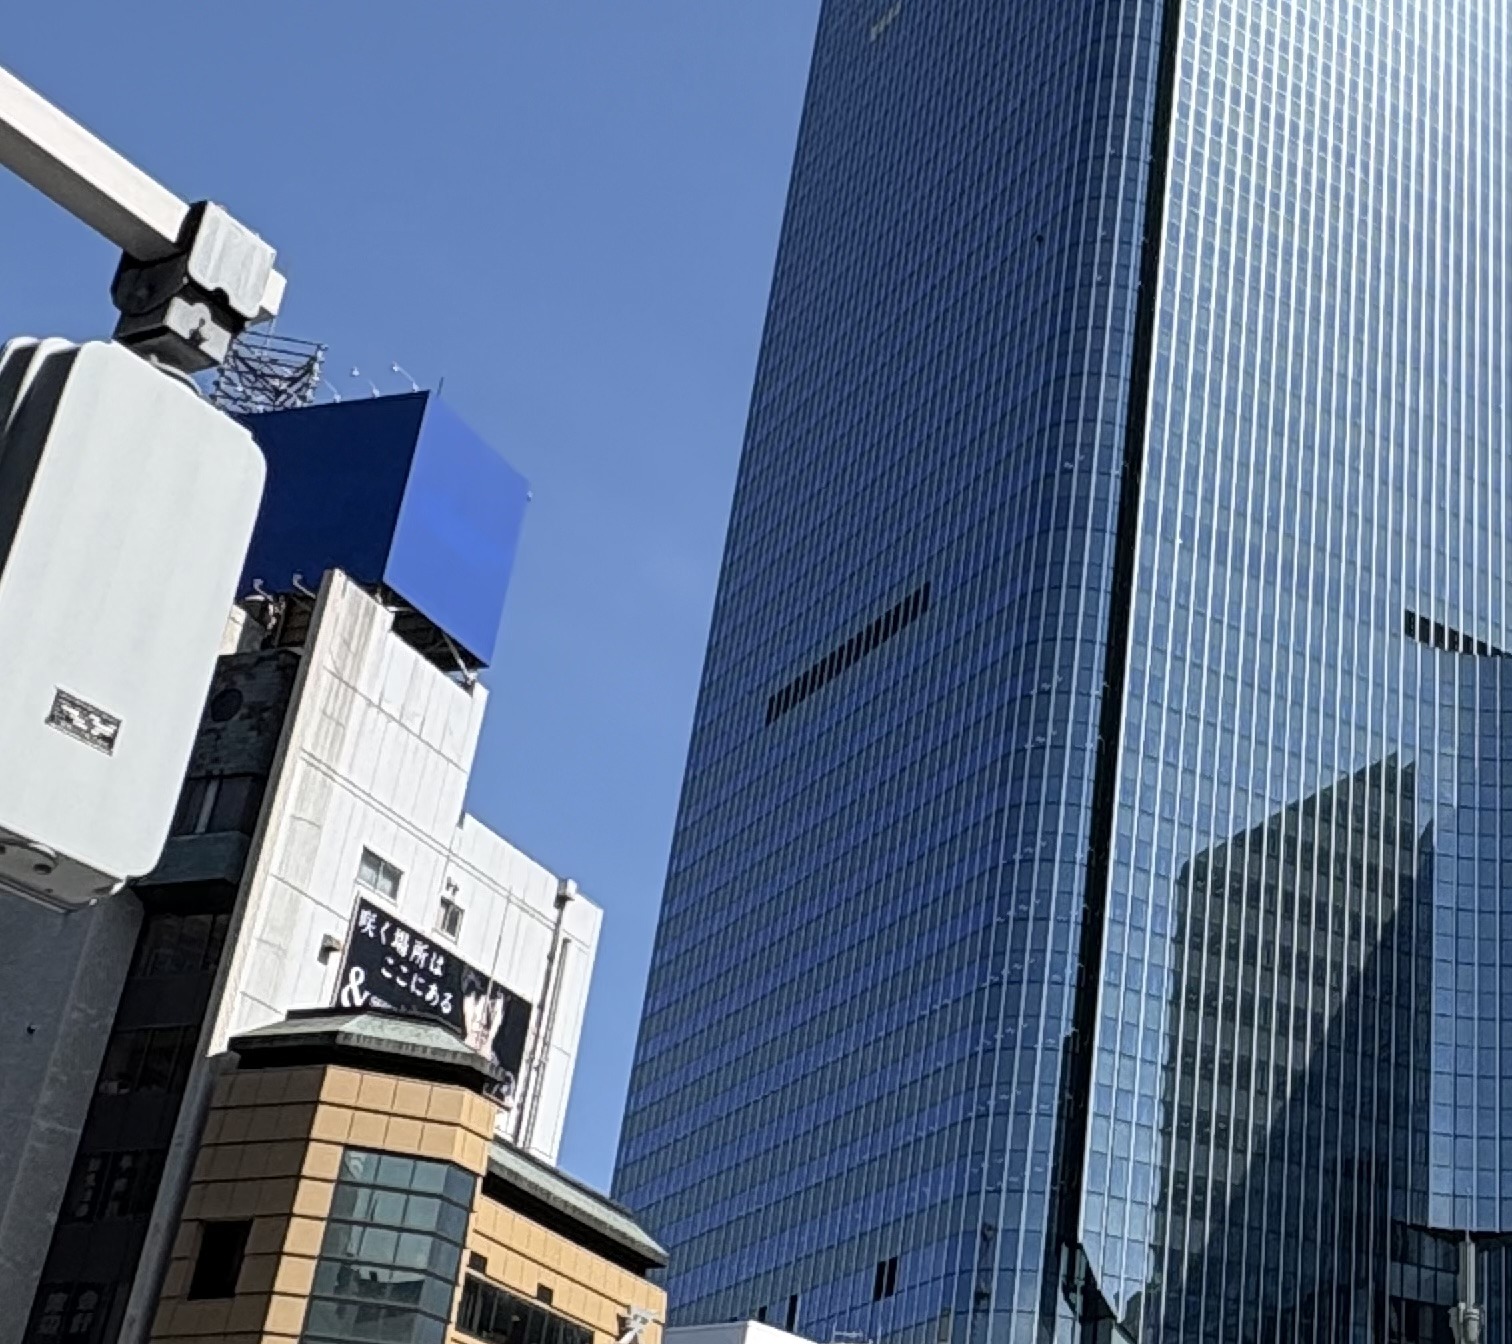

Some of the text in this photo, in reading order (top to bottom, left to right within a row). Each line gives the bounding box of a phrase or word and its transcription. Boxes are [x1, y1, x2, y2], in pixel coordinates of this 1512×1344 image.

[358, 909, 444, 977] 咲く場所は
[380, 956, 453, 1014] ここにある
